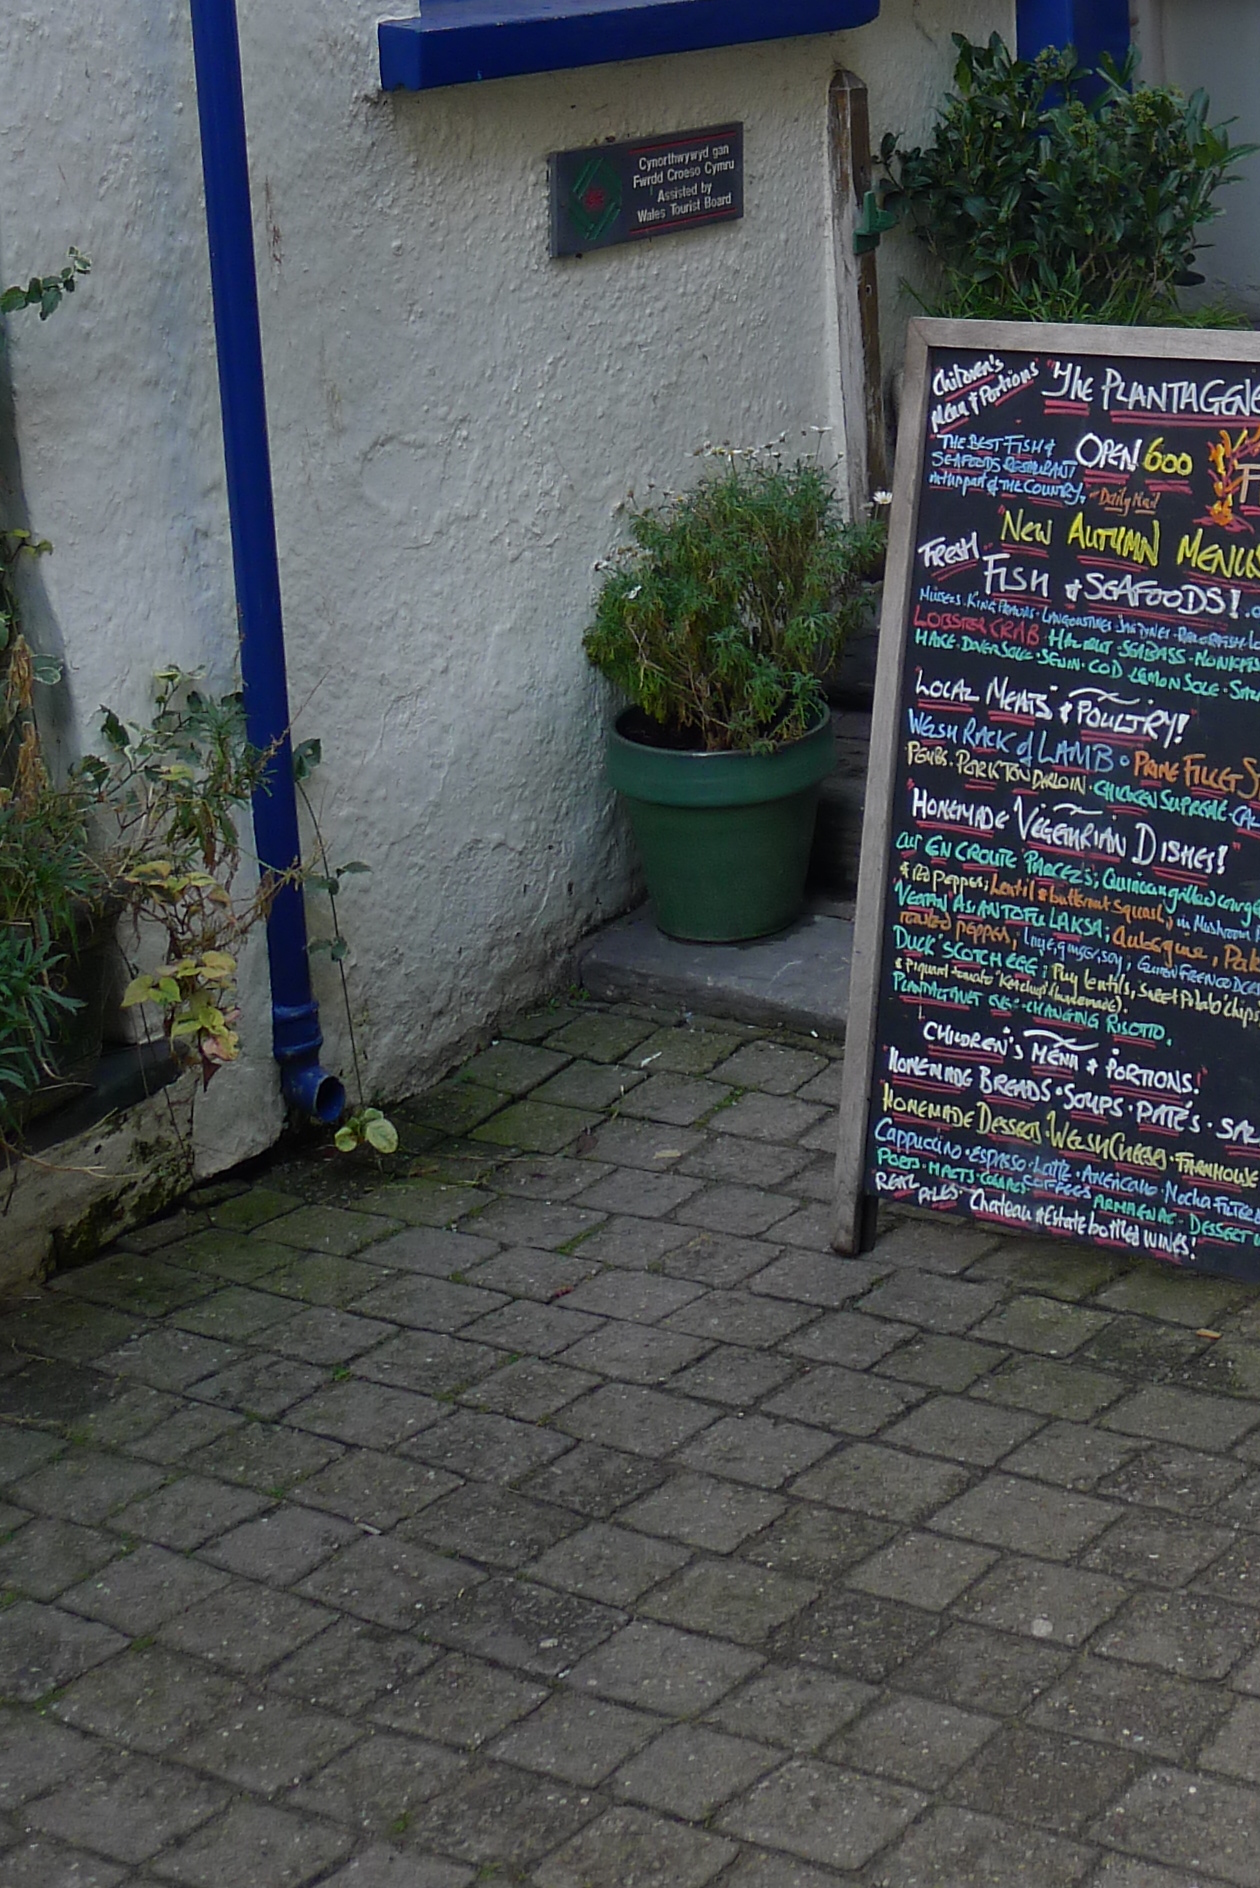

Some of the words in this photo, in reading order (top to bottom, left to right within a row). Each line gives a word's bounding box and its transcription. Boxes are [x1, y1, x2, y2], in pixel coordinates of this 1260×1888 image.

[639, 145, 709, 172] Cynorthwywyd
[712, 144, 729, 159] gan
[633, 171, 663, 188] Fwrdd
[667, 166, 700, 181] Croeso
[705, 160, 735, 176] Cymru
[657, 183, 698, 202] Assisted
[701, 181, 712, 194] by
[637, 208, 666, 223] Wales
[670, 199, 700, 217] Tourist
[705, 192, 731, 209] Board
[969, 436, 1004, 450] BEST
[1075, 432, 1143, 472] OPEN!
[1143, 437, 1192, 476] 600
[1067, 512, 1160, 566] AUTUMN
[913, 605, 987, 634] LOBSTER
[1087, 660, 1123, 679] COD
[907, 708, 957, 744] WELSH
[963, 717, 1017, 753] RACK
[1038, 729, 1115, 773] LAMB
[955, 841, 1017, 869] CROUTE
[979, 1065, 1052, 1102] BREADS
[1063, 1083, 1124, 1117] SOUPS
